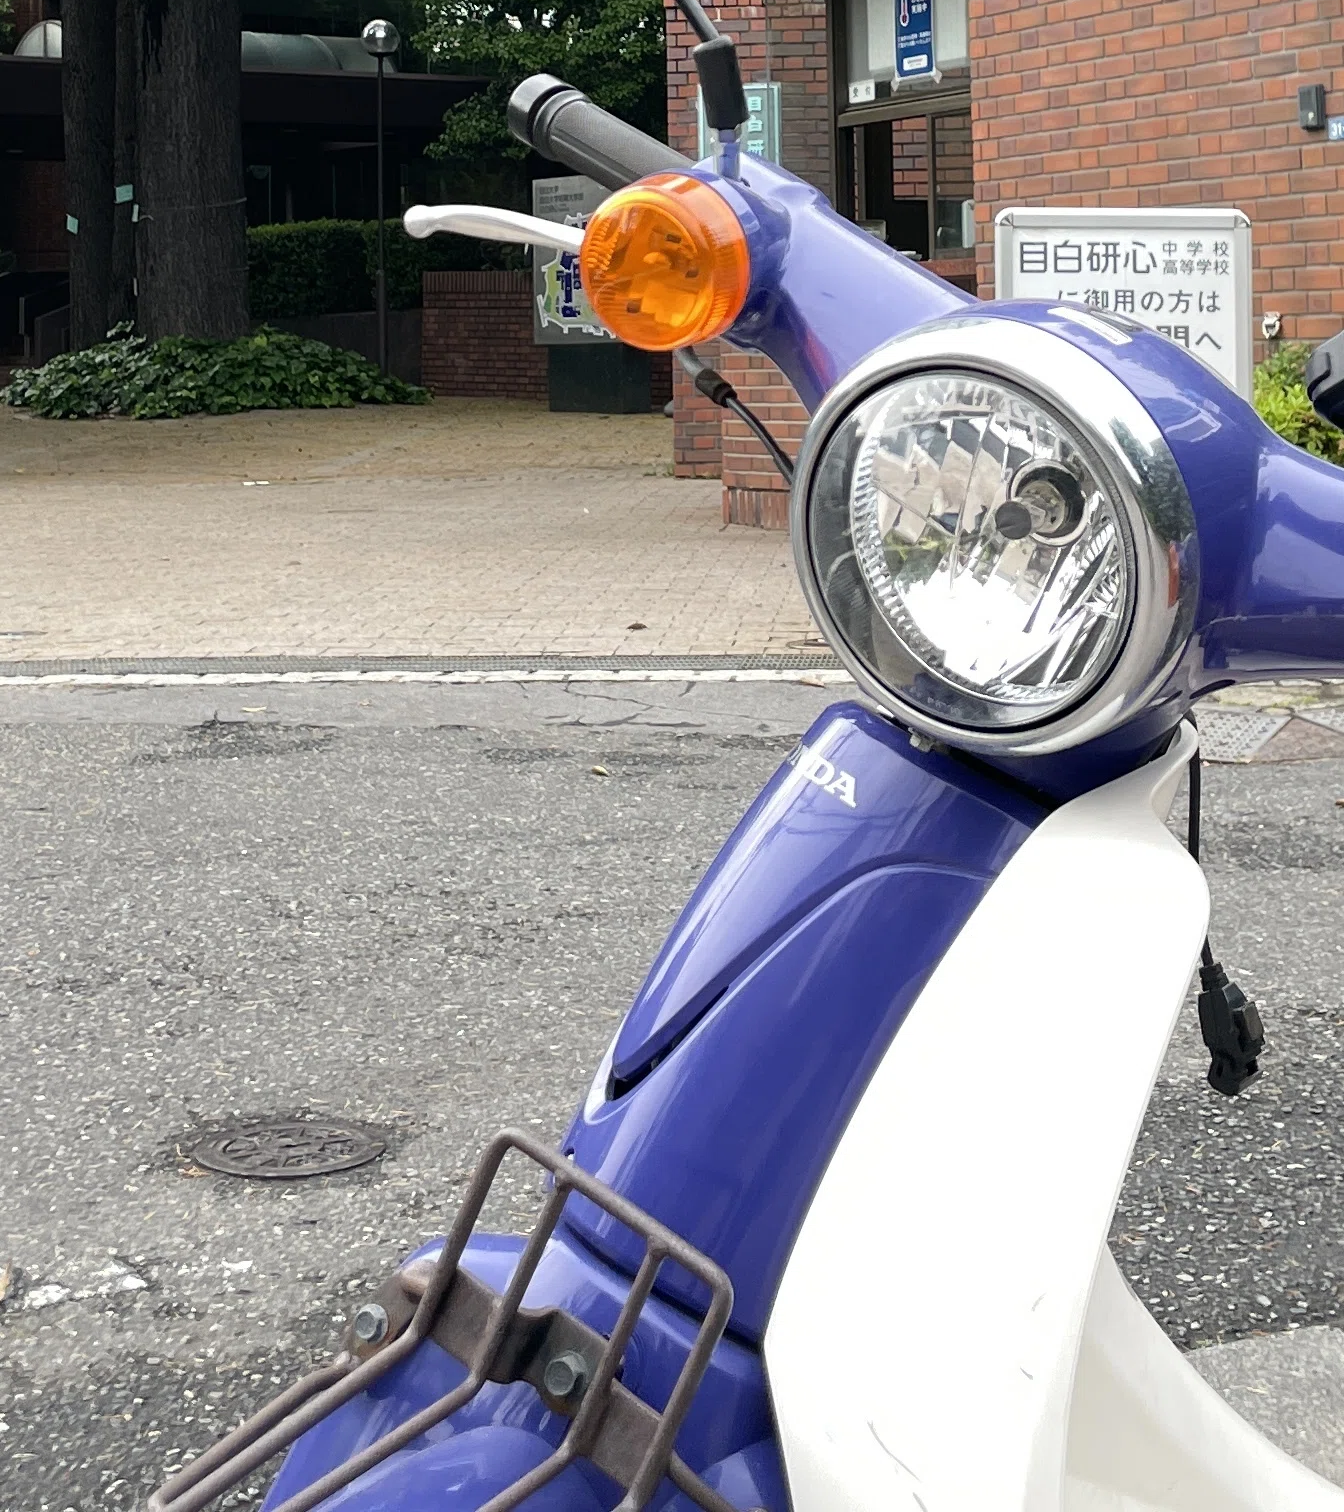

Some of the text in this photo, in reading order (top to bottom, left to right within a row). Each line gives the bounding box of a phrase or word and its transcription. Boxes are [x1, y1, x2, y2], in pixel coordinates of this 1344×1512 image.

[1019, 239, 1158, 274] 目白研心
[1162, 240, 1230, 257] 中学校
[1162, 258, 1230, 276] 高等学校
